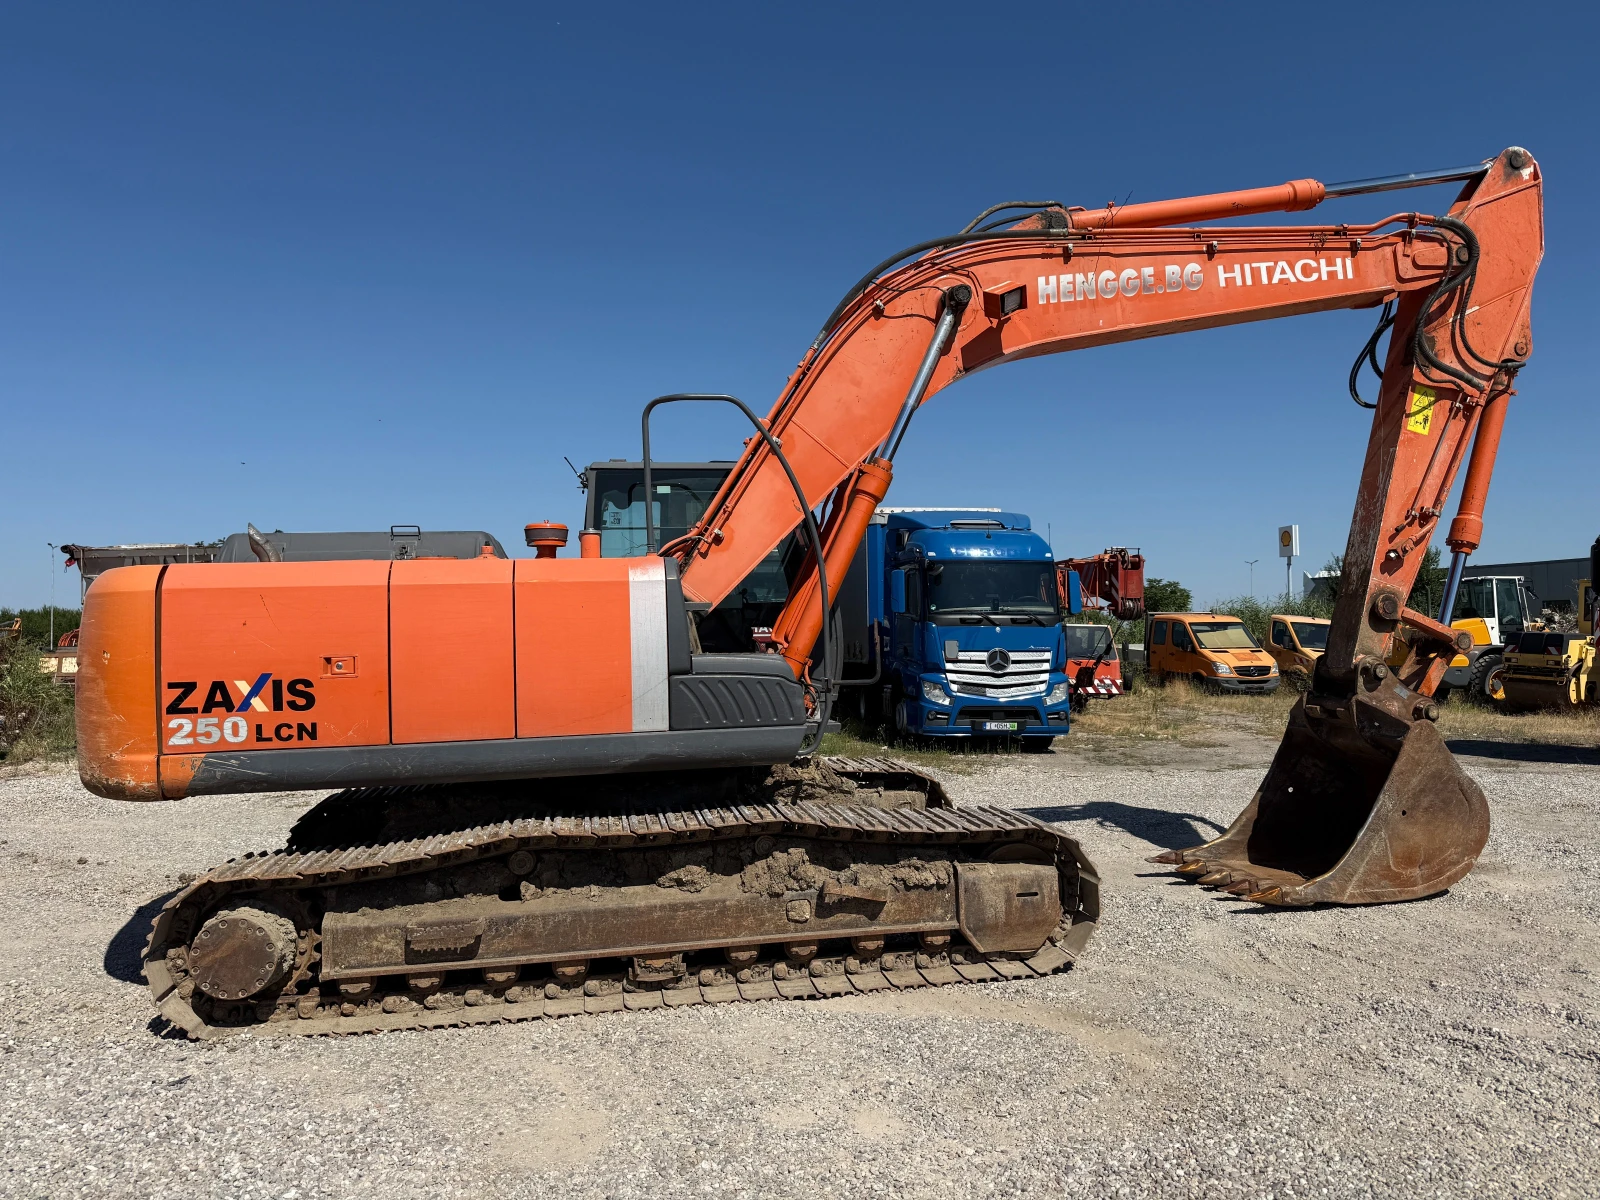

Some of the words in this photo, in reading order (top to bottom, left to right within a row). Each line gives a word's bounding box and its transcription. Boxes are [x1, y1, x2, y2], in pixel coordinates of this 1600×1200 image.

[1037, 262, 1204, 305] HENGGE.BG
[1217, 257, 1354, 288] HITACHI
[165, 672, 316, 715] ZAXIS
[167, 716, 249, 746] 250
[255, 722, 318, 743] LCN
